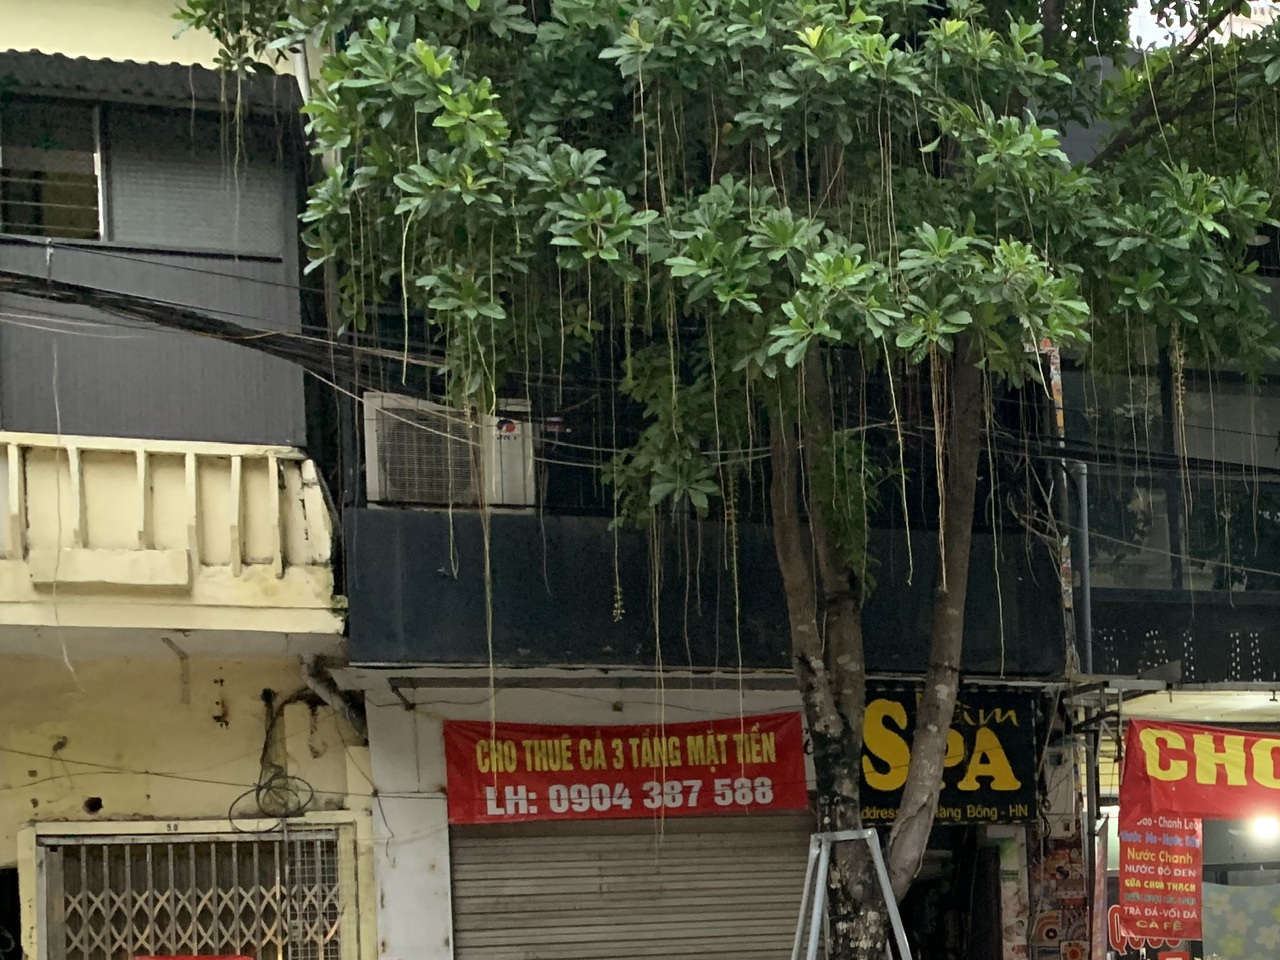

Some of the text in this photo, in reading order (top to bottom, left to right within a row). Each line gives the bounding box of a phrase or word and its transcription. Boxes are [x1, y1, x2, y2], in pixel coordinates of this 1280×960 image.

[476, 739, 517, 773] CHO
[522, 733, 574, 772] THUÊ
[612, 738, 624, 770] 3
[686, 729, 728, 773] MẶT
[486, 776, 774, 816] LH: 0904 387 588
[966, 804, 998, 819] Bông
[1009, 804, 1028, 817] HN
[1158, 816, 1183, 829] Chanh
[1127, 847, 1193, 864] Nước Chanh
[1124, 863, 1155, 875] NƯỚC
[1123, 906, 1142, 916] TRÀ
[1182, 909, 1198, 919] ĐÁ
[1135, 920, 1183, 931] CÀ FÊ
